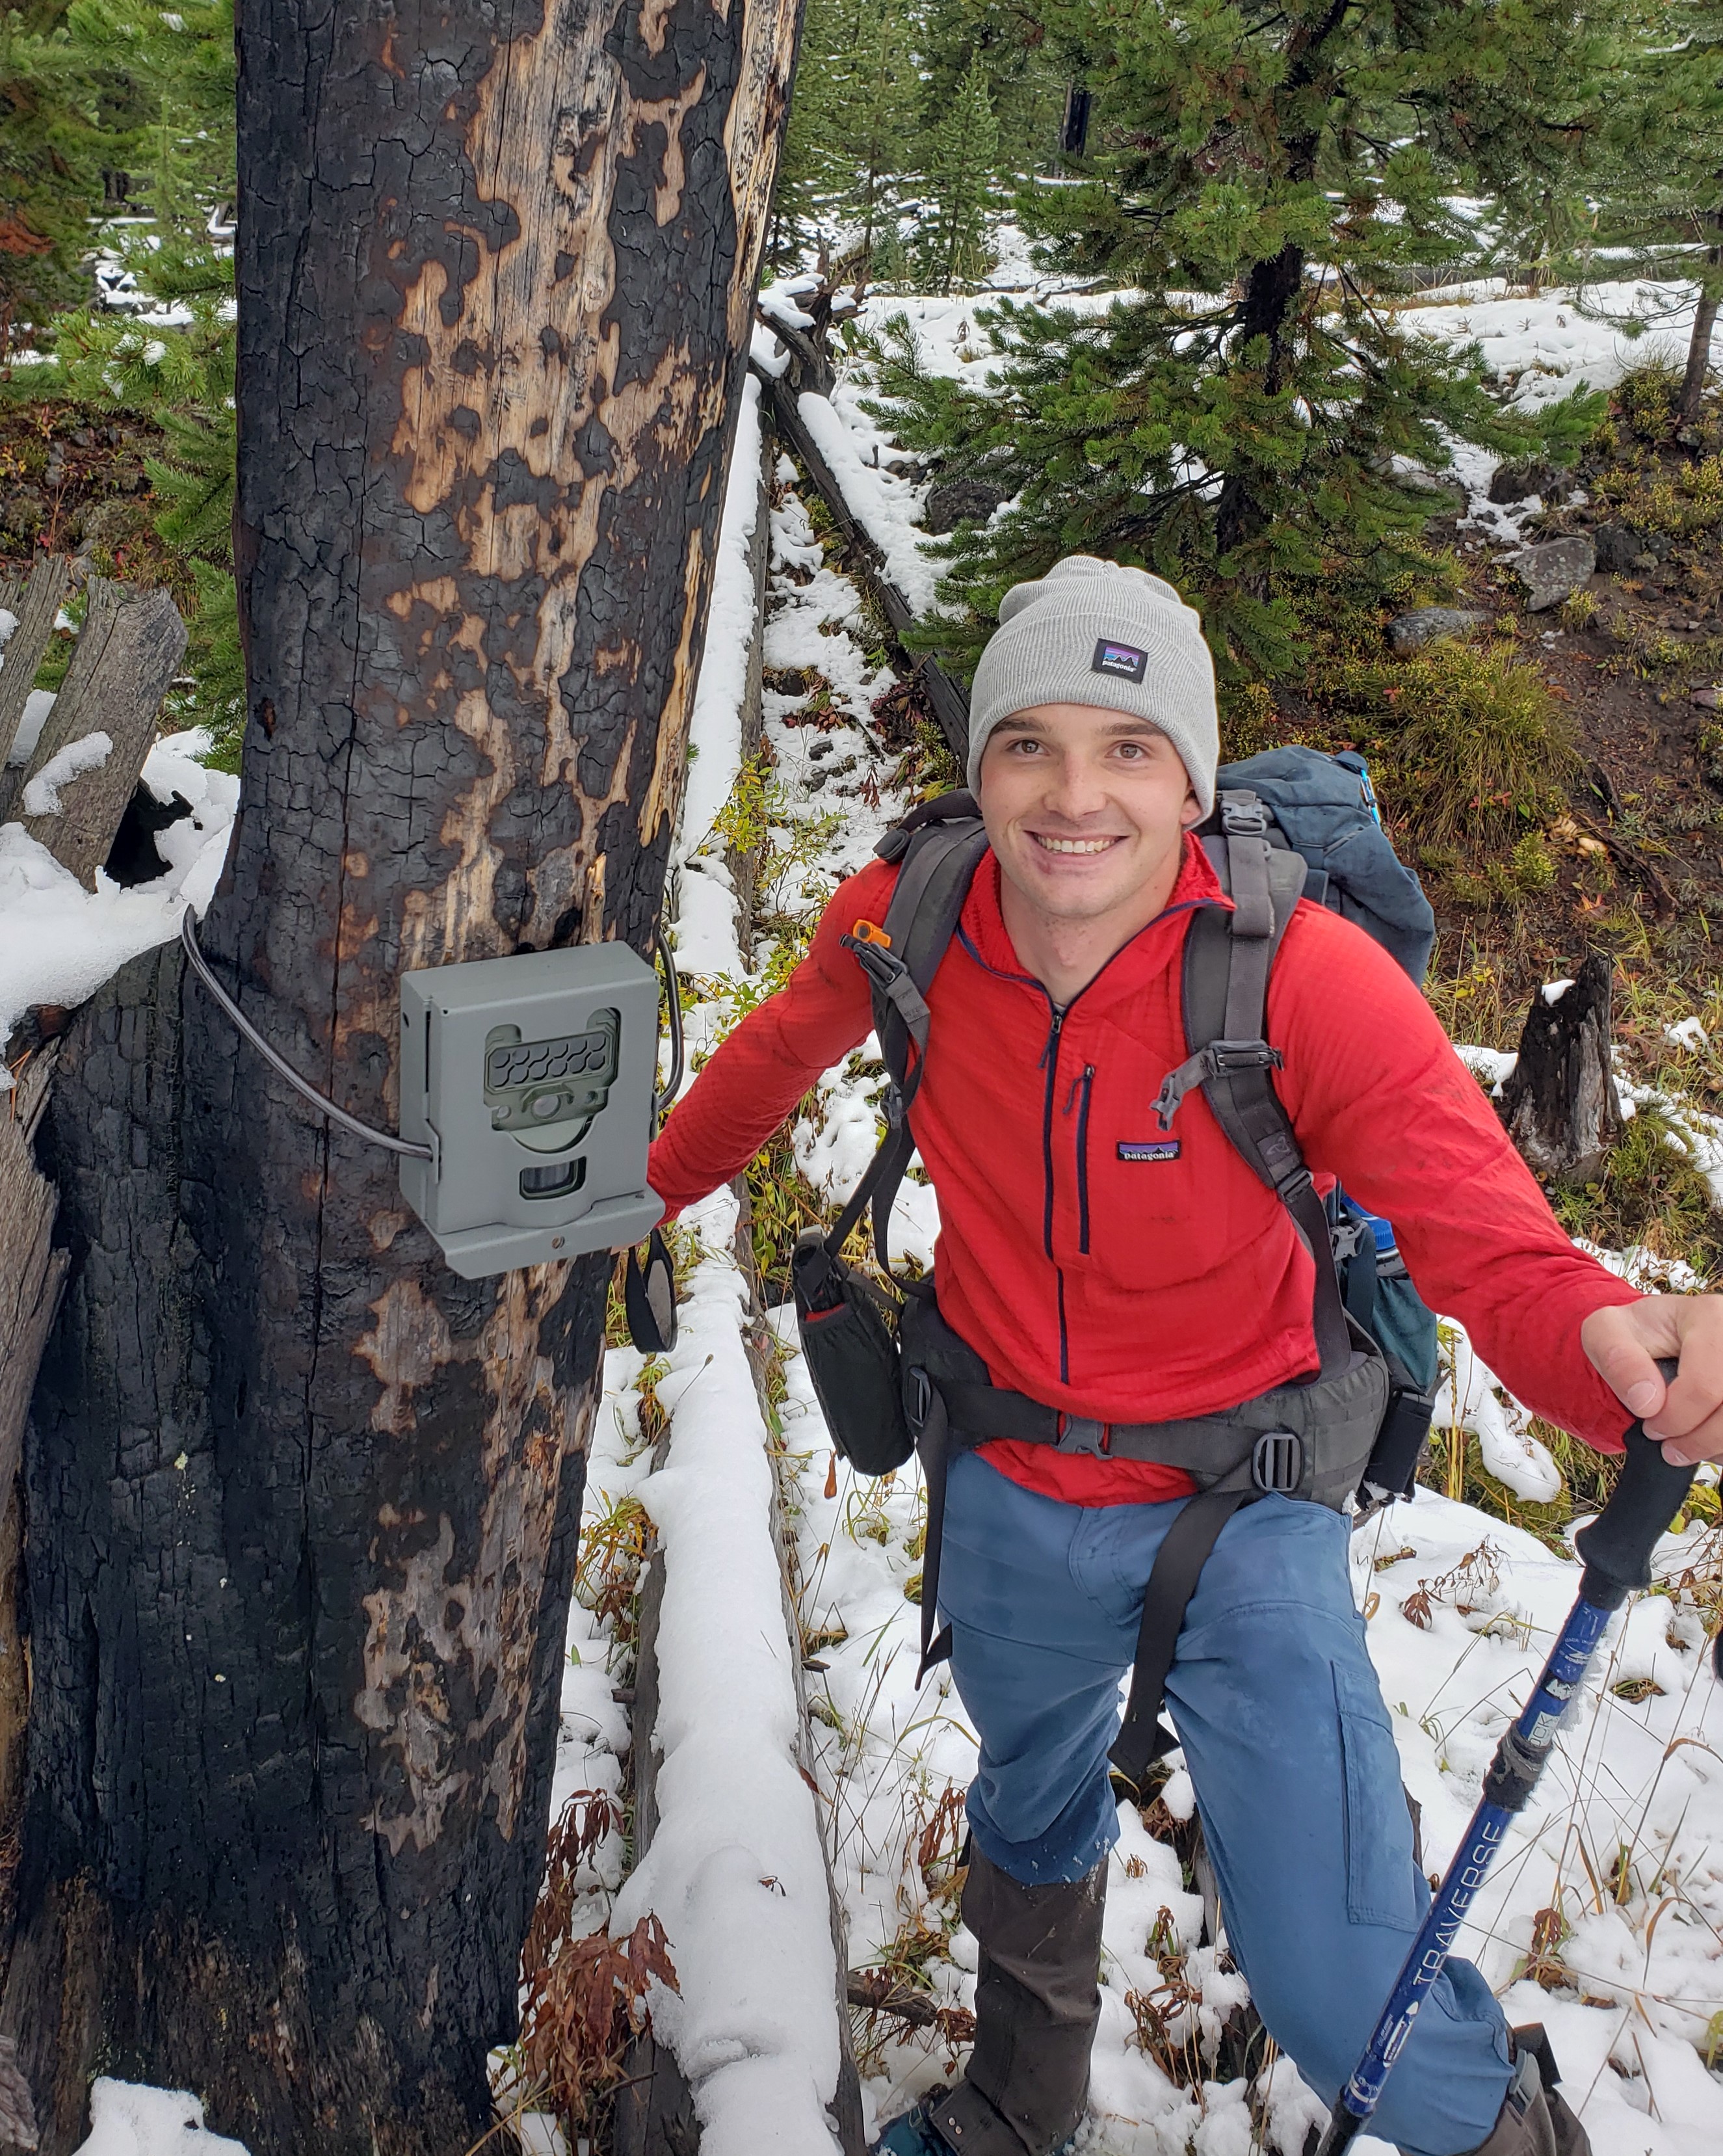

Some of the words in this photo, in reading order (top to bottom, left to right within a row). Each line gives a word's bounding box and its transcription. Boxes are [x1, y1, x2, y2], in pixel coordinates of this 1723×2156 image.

[1102, 660, 1135, 672] patagonia
[1124, 1152, 1174, 1161] patagonia
[1413, 1822, 1503, 1985] TRAVERSE
